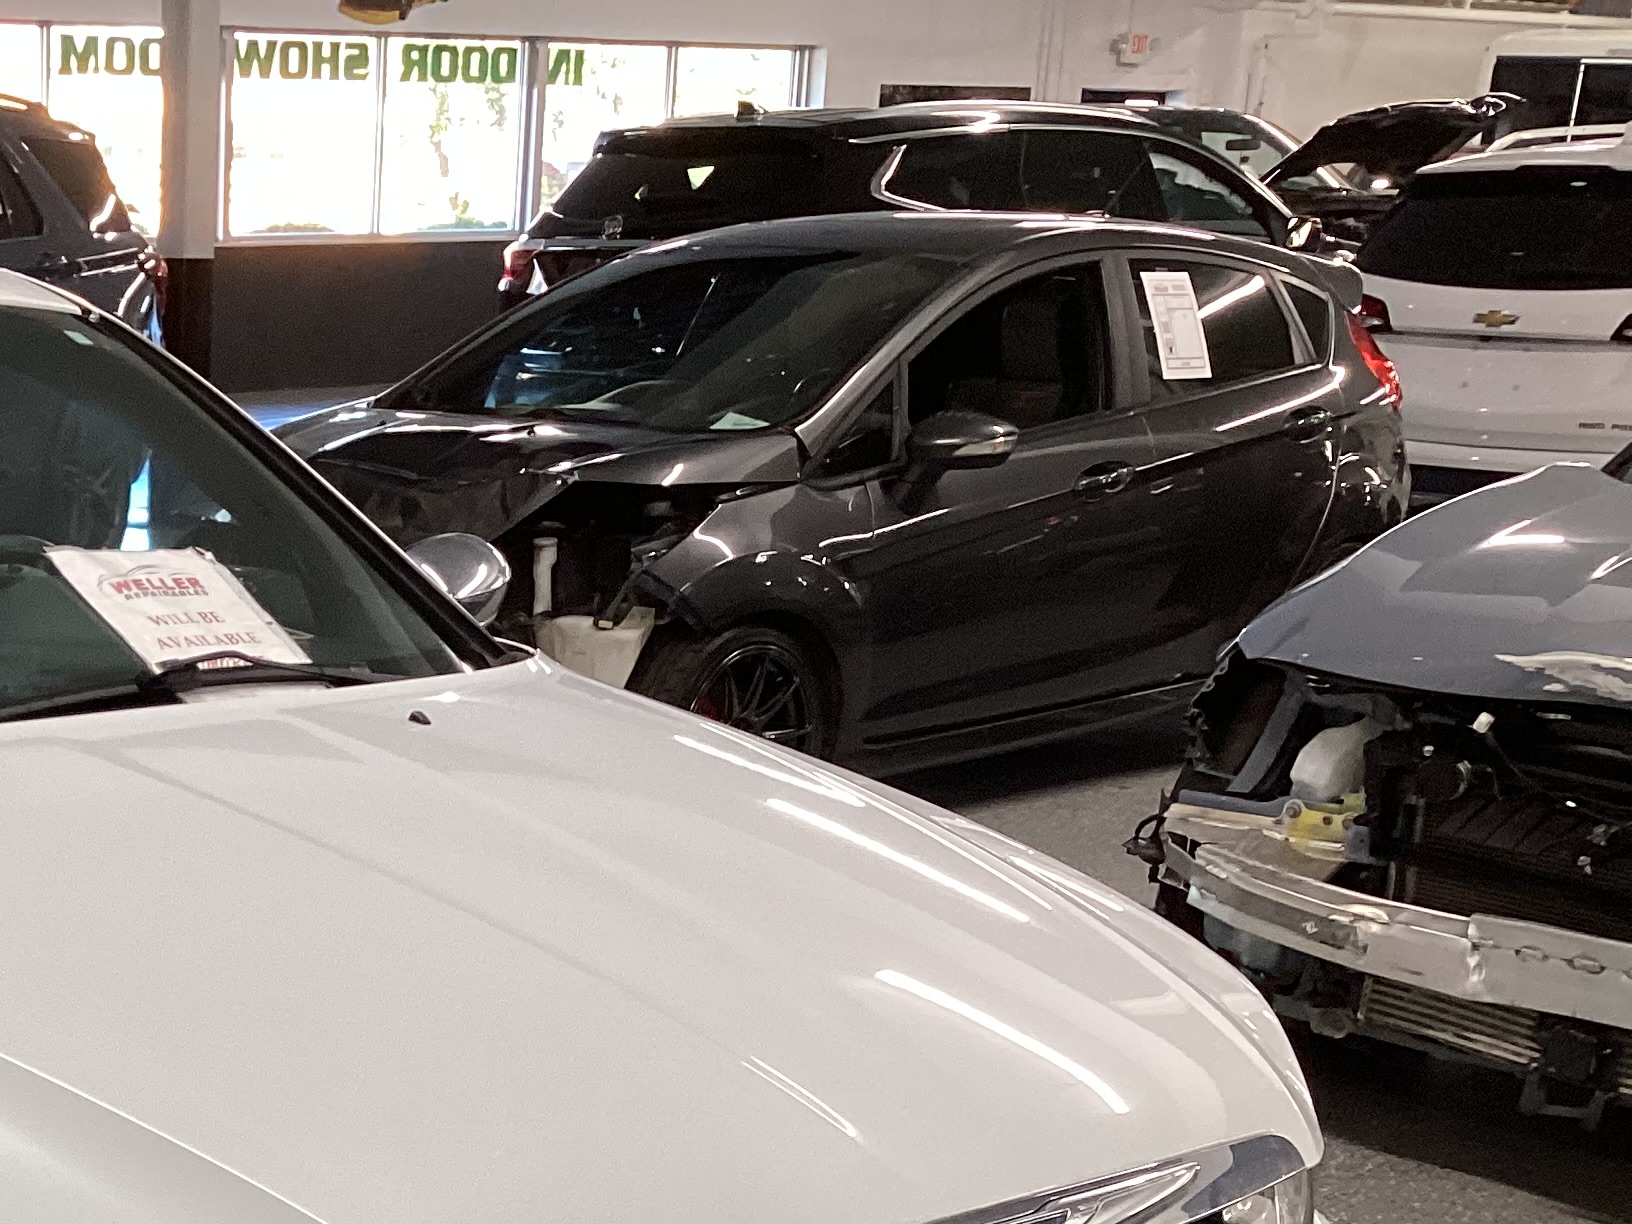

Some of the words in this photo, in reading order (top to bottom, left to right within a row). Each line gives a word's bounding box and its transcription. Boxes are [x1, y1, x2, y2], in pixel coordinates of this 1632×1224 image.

[111, 577, 204, 594] WELLER
[147, 612, 199, 626] WILL
[198, 611, 225, 624] BE
[156, 631, 262, 650] AVAILABLE
